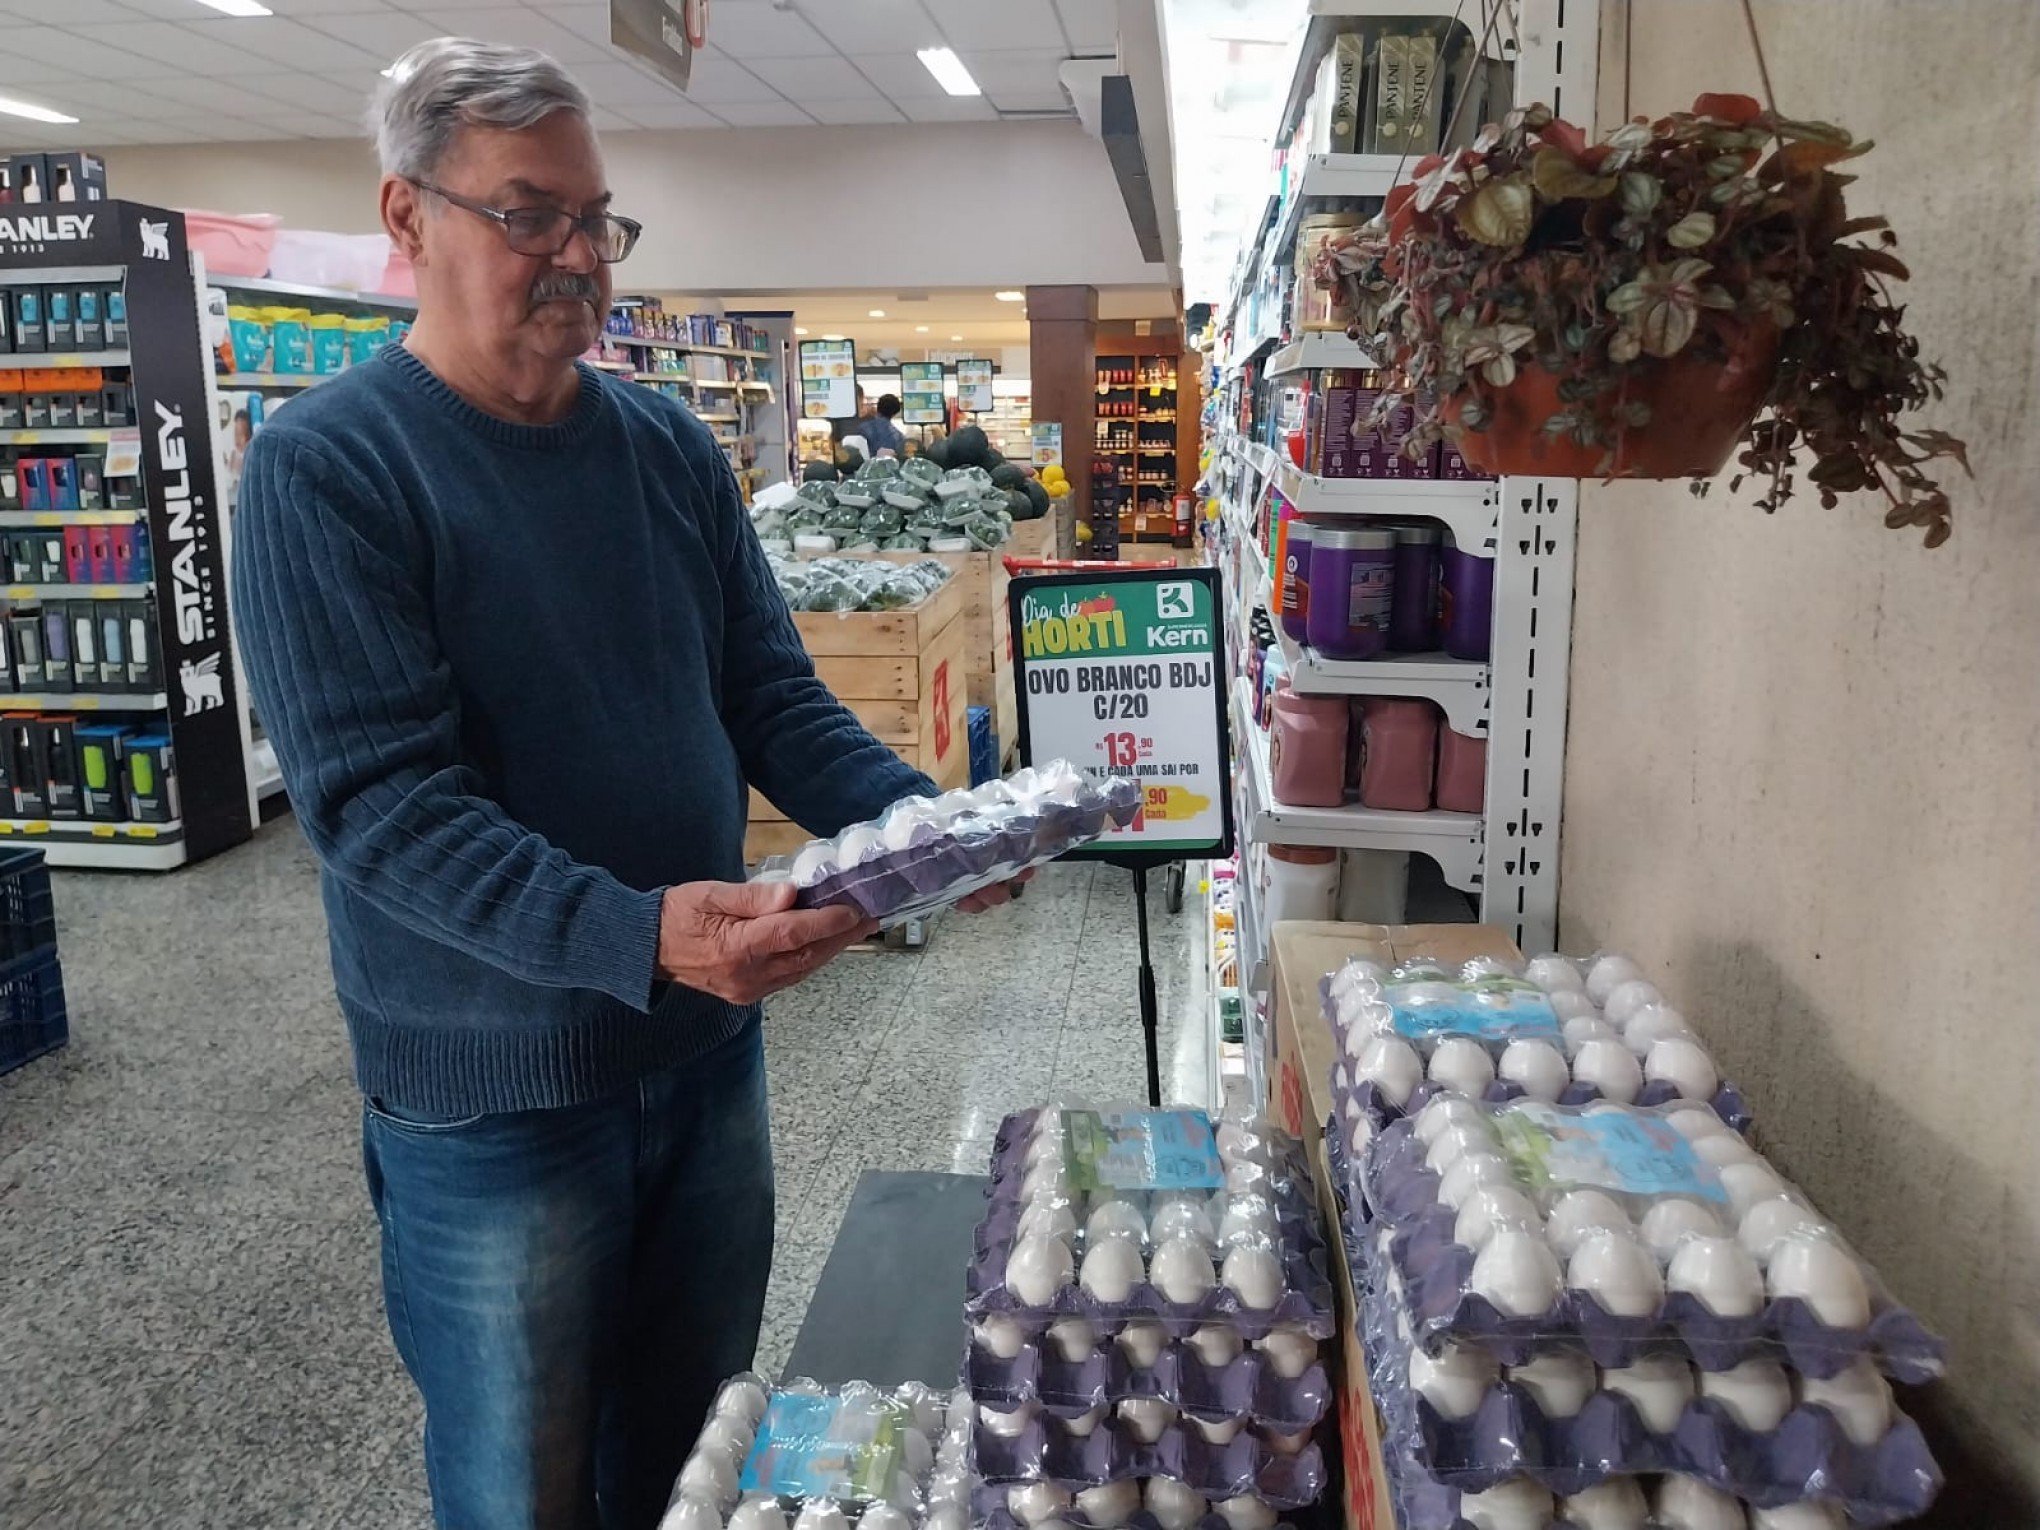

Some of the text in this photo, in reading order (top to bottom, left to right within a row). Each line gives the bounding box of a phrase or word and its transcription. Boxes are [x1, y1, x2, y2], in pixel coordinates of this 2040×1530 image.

[1338, 60, 1353, 118] PANTENE
[1385, 63, 1399, 119] PANTENE
[154, 399, 204, 645] STANLEY
[1022, 610, 1127, 658] HORTI
[1147, 625, 1209, 648] Kern
[1028, 662, 1211, 695] OVO BRANCO BDJ
[1094, 693, 1149, 720] C/20
[1107, 765, 1133, 777] CADA
[1136, 764, 1159, 776] UMA
[1161, 764, 1177, 776] SAI
[1180, 763, 1200, 775] POR
